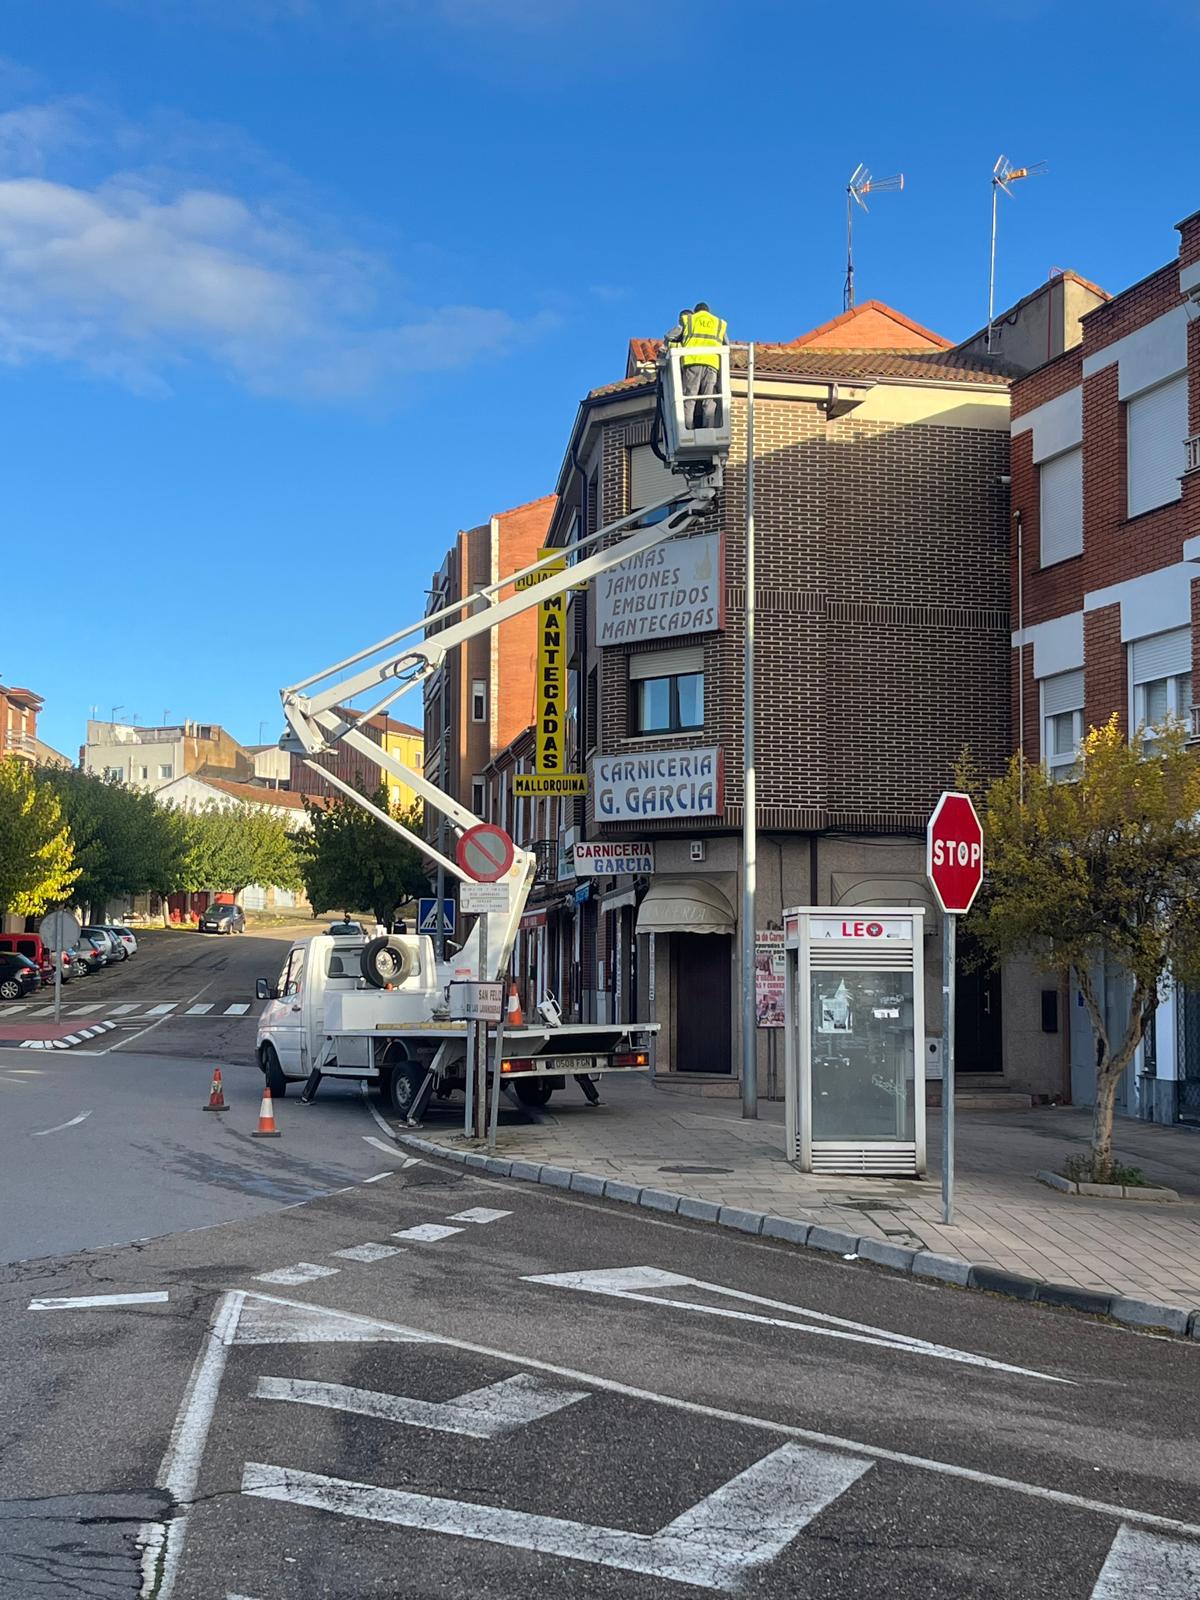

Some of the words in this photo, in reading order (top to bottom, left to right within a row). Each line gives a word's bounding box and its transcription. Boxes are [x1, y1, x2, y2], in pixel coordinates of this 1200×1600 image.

[605, 568, 681, 599] JAMONES
[612, 585, 709, 616] EMBUTIDOS
[602, 607, 714, 640] MANTECADAS
[543, 596, 562, 769] MANTECADAS
[600, 754, 712, 783] CARNICERIA
[516, 779, 585, 792] MALLORQUINA
[599, 788, 620, 815] G.
[625, 781, 713, 815] GARCIA
[576, 843, 652, 858] CARNICERIA
[594, 857, 652, 873] GARCIA
[933, 839, 980, 868] STOP
[841, 921, 884, 937] LEO
[478, 989, 489, 1001] SAN
